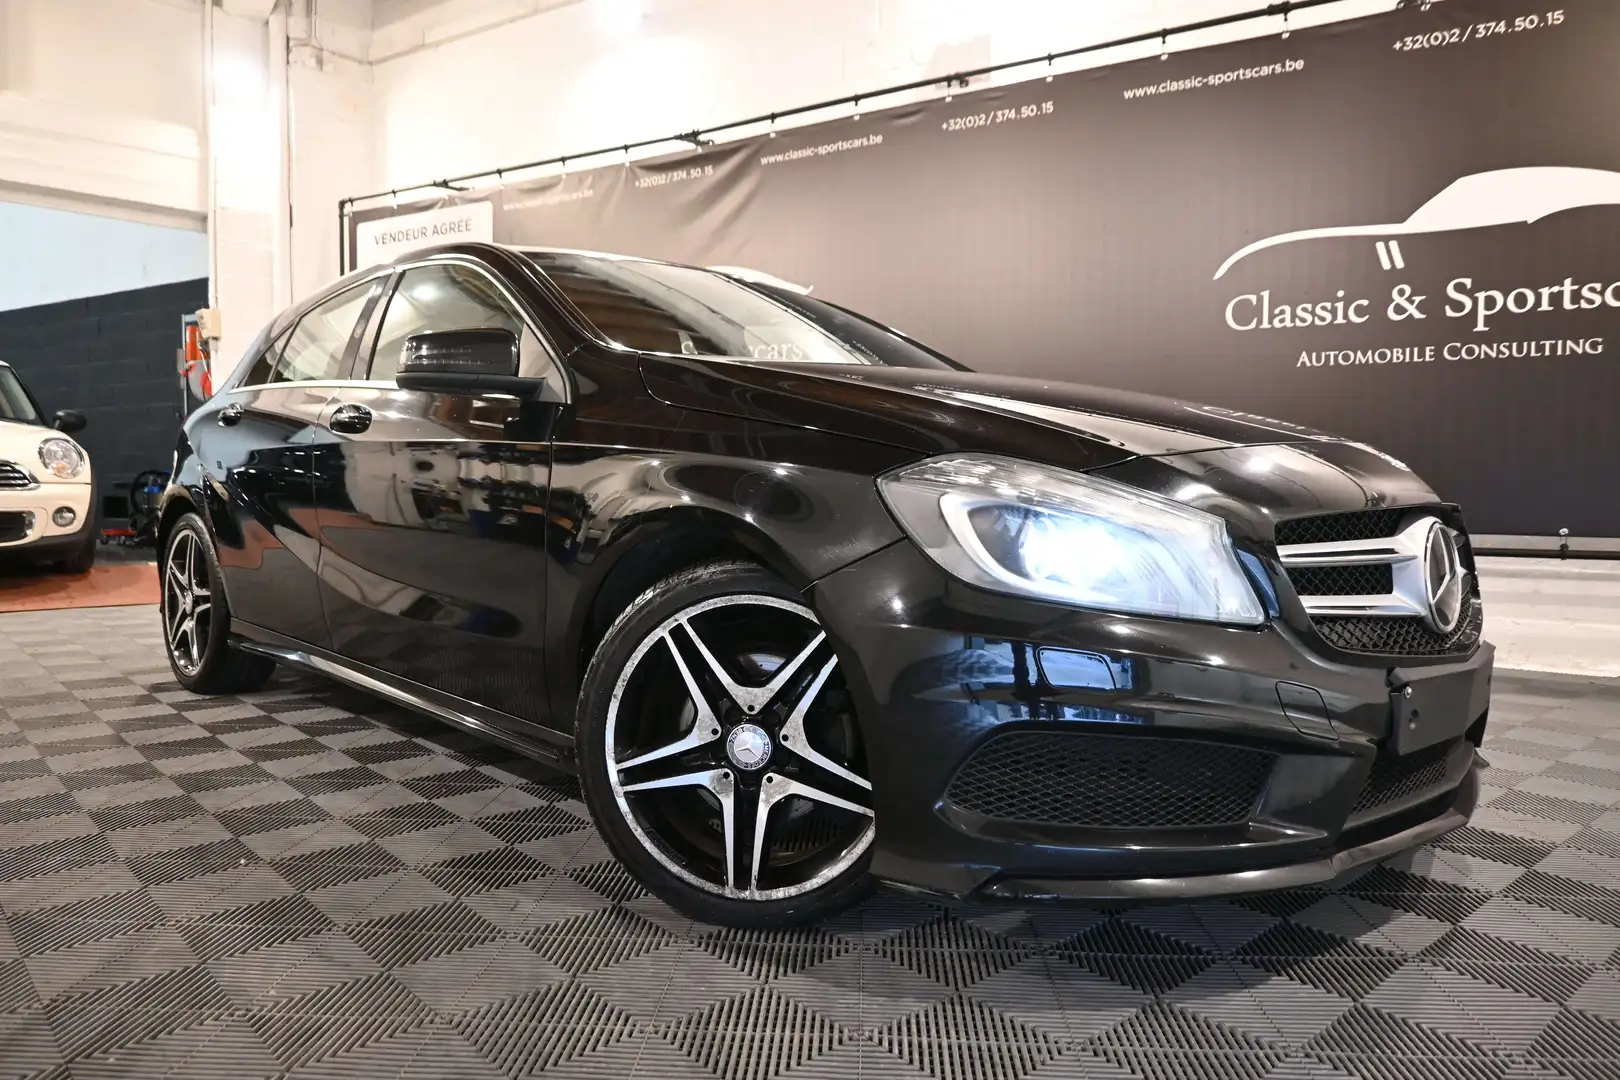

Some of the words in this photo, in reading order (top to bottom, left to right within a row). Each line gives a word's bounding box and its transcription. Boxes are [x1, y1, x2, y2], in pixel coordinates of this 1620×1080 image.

[1122, 58, 1305, 100] www.classic-sportscars.be
[760, 134, 884, 166] www.classic-sportscars.be
[374, 226, 428, 246] VENDEUR
[1224, 289, 1370, 332] Classic
[1386, 283, 1427, 322] &
